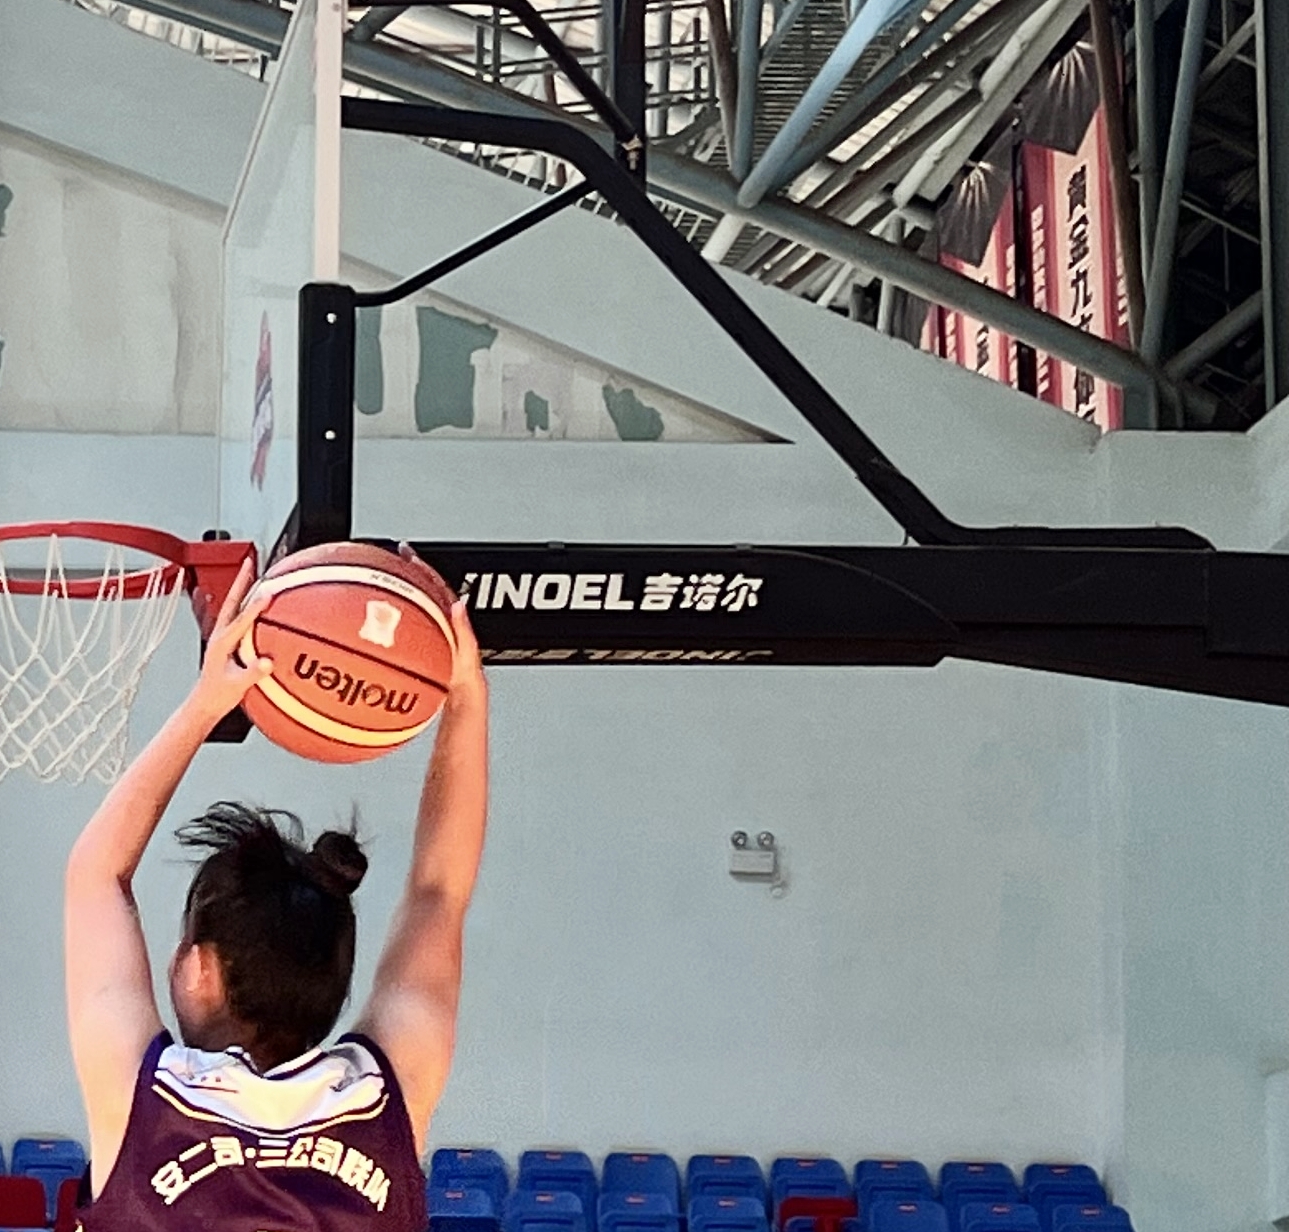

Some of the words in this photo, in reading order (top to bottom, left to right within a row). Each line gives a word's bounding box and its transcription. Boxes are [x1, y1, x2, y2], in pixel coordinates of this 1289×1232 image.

[459, 572, 634, 610] INOEL
[640, 572, 763, 612] 吉诺尔
[294, 652, 420, 715] molten
